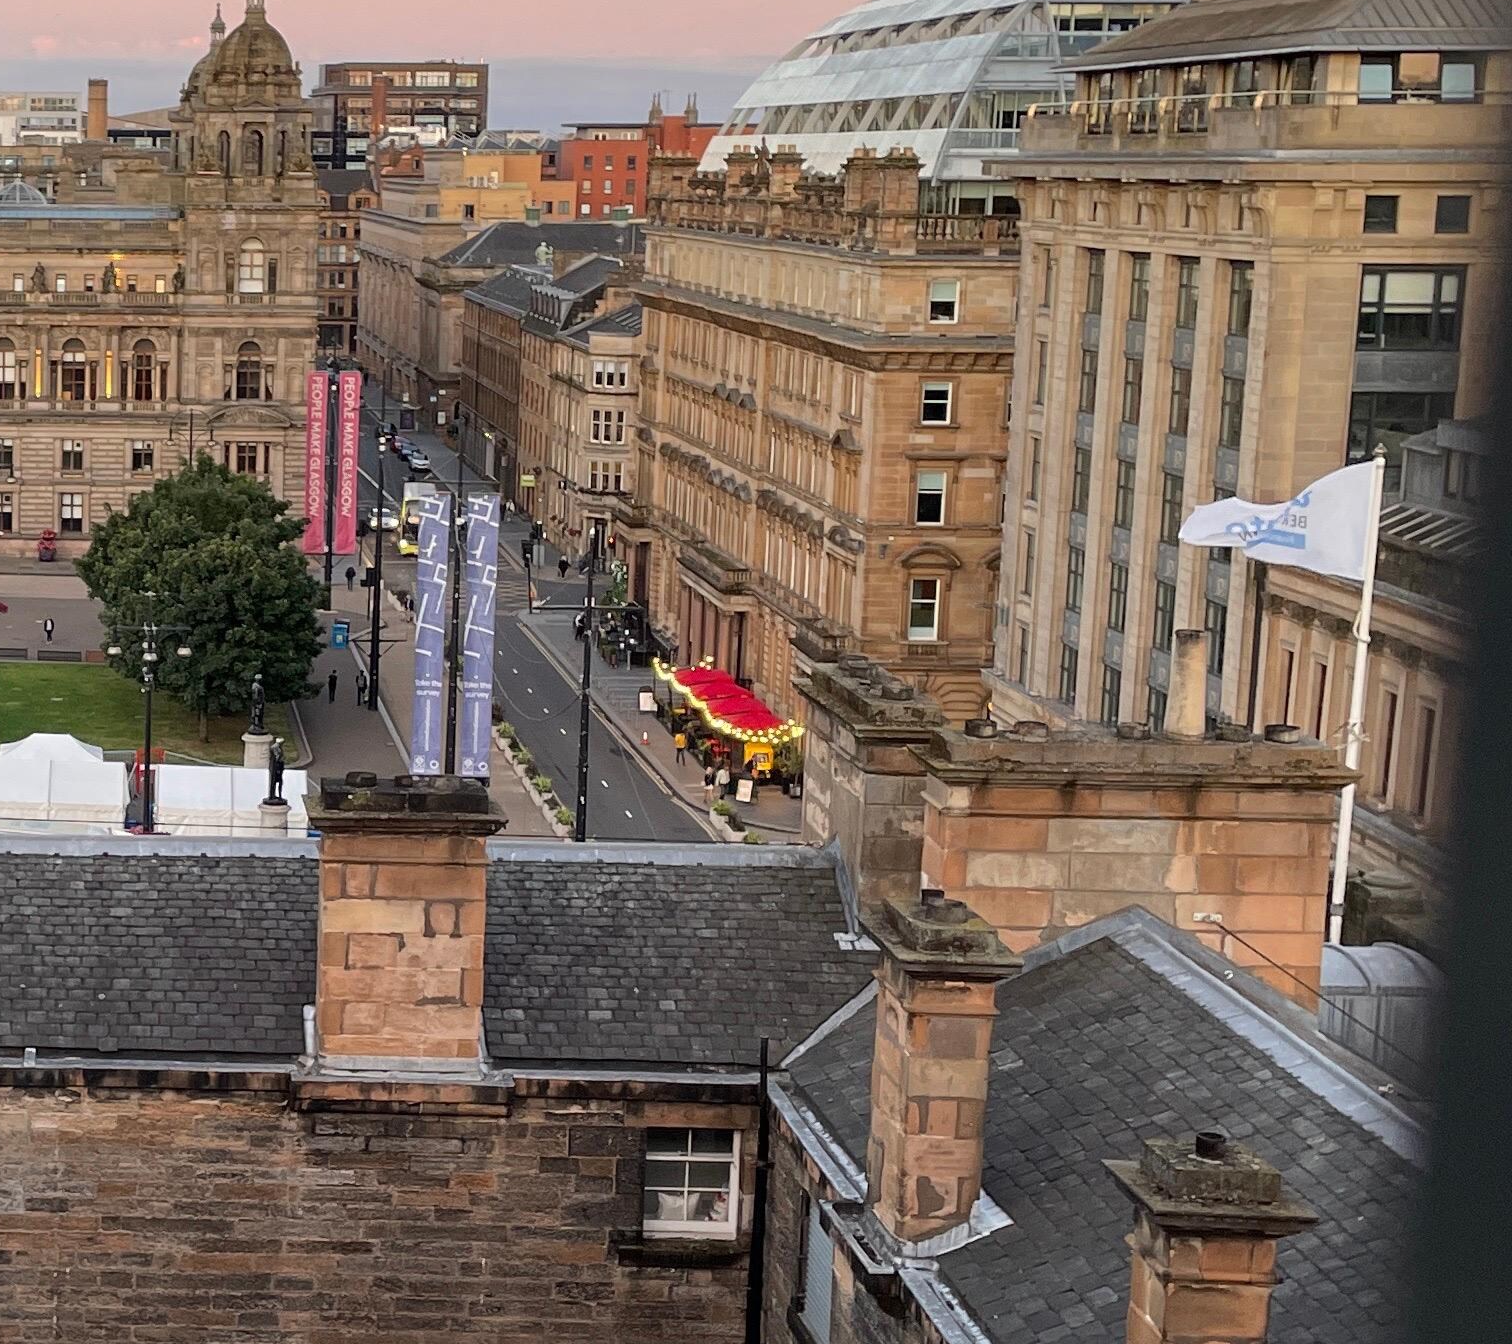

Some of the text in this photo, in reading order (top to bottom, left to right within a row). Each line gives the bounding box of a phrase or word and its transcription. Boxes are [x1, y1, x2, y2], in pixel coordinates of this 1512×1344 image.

[308, 376, 323, 517] PEOPLE MAKE GLASGOW
[340, 376, 355, 518] PEOPLE MAKE GLASGOW
